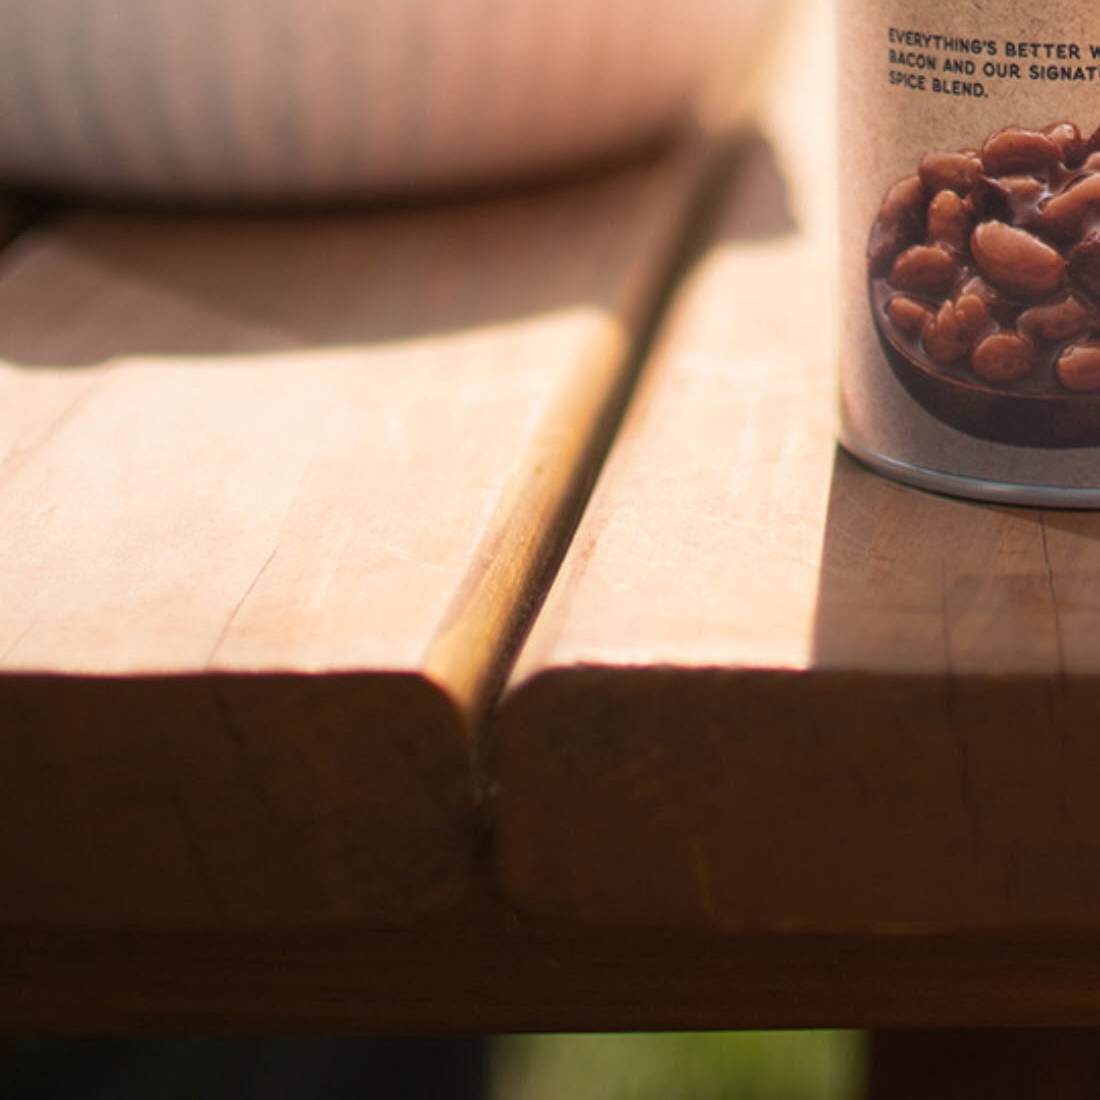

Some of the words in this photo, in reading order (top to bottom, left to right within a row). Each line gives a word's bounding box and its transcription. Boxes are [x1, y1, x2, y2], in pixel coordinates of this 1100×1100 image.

[888, 28, 998, 55] EVERYTHING'S
[1004, 41, 1081, 60] BETTER
[889, 49, 936, 70] BACON
[943, 58, 976, 76] AND
[982, 62, 1022, 80] OUR
[889, 71, 926, 90] SPICE
[932, 78, 989, 98] BLEND.
